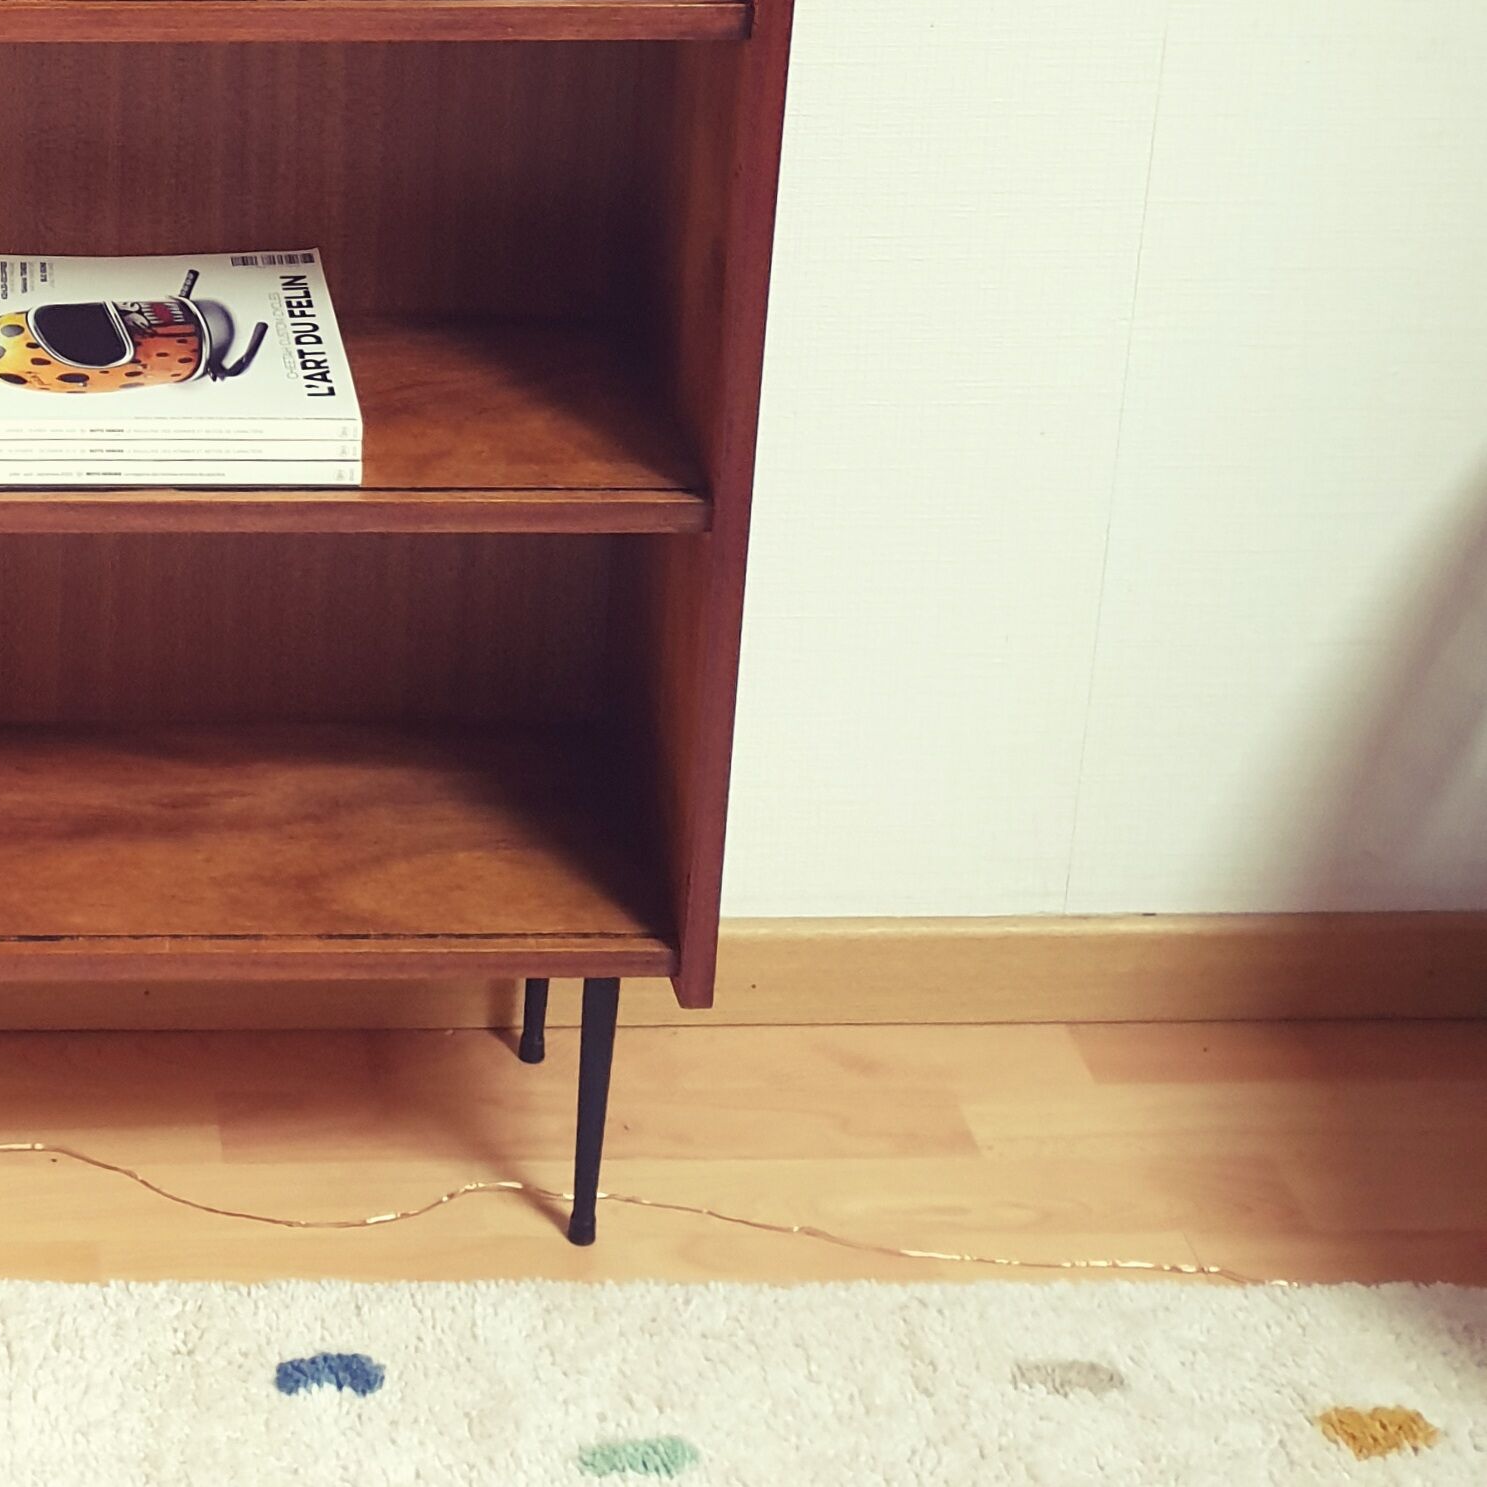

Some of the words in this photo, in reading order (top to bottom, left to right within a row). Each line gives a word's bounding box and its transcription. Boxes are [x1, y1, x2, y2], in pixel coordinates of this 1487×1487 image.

[279, 275, 317, 318] FELIN
[290, 322, 323, 345] DU
[296, 348, 336, 397] L'ART
